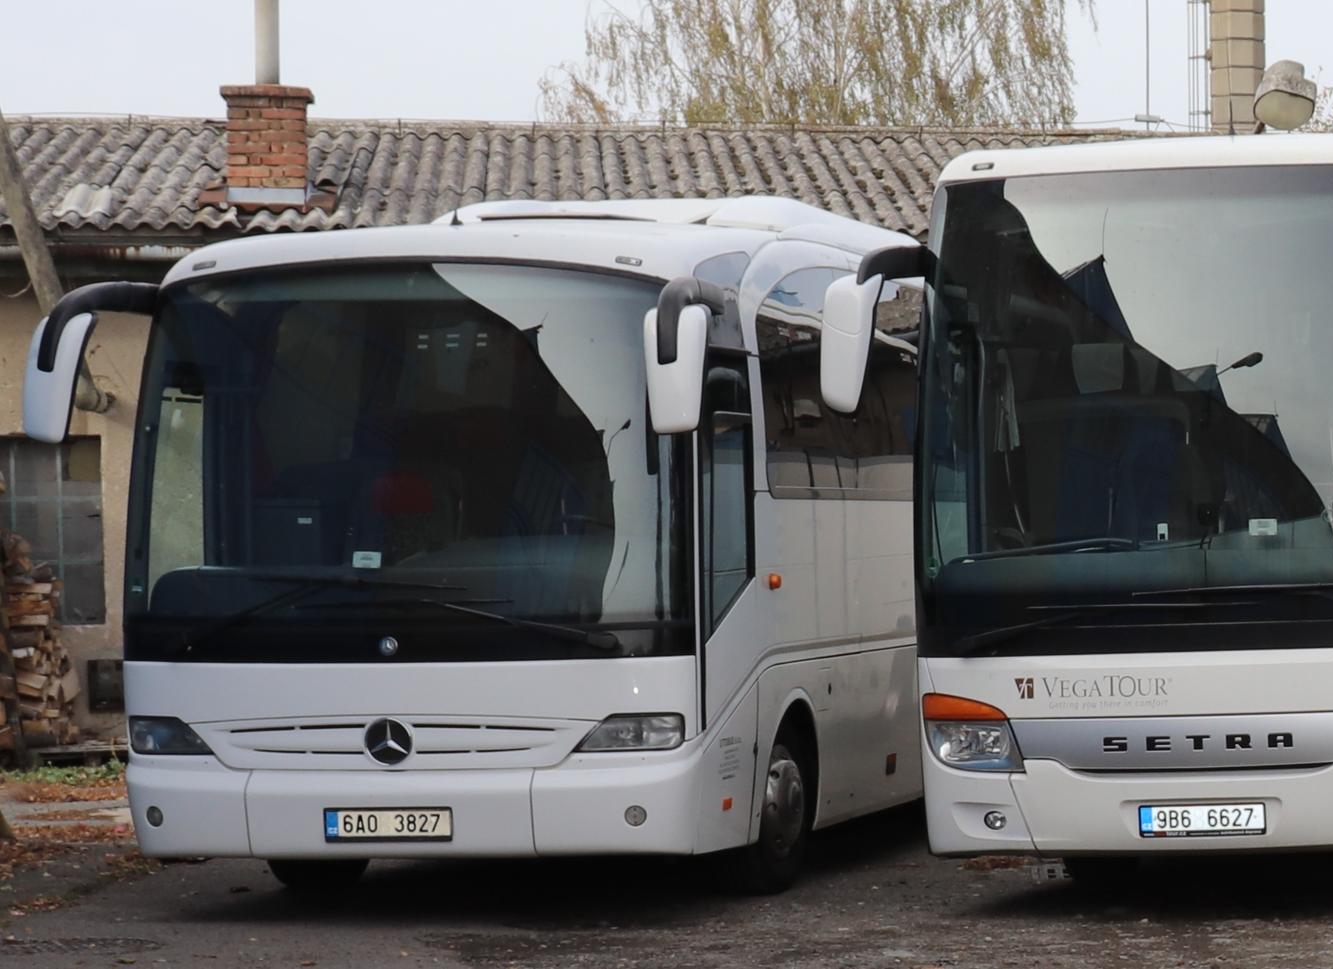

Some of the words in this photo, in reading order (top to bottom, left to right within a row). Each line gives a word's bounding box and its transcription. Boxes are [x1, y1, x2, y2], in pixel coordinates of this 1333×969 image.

[1103, 733, 1294, 751] SETRA
[394, 813, 441, 833] 3827
[1157, 810, 1191, 829] 9B6
[1207, 808, 1254, 827] 6627
